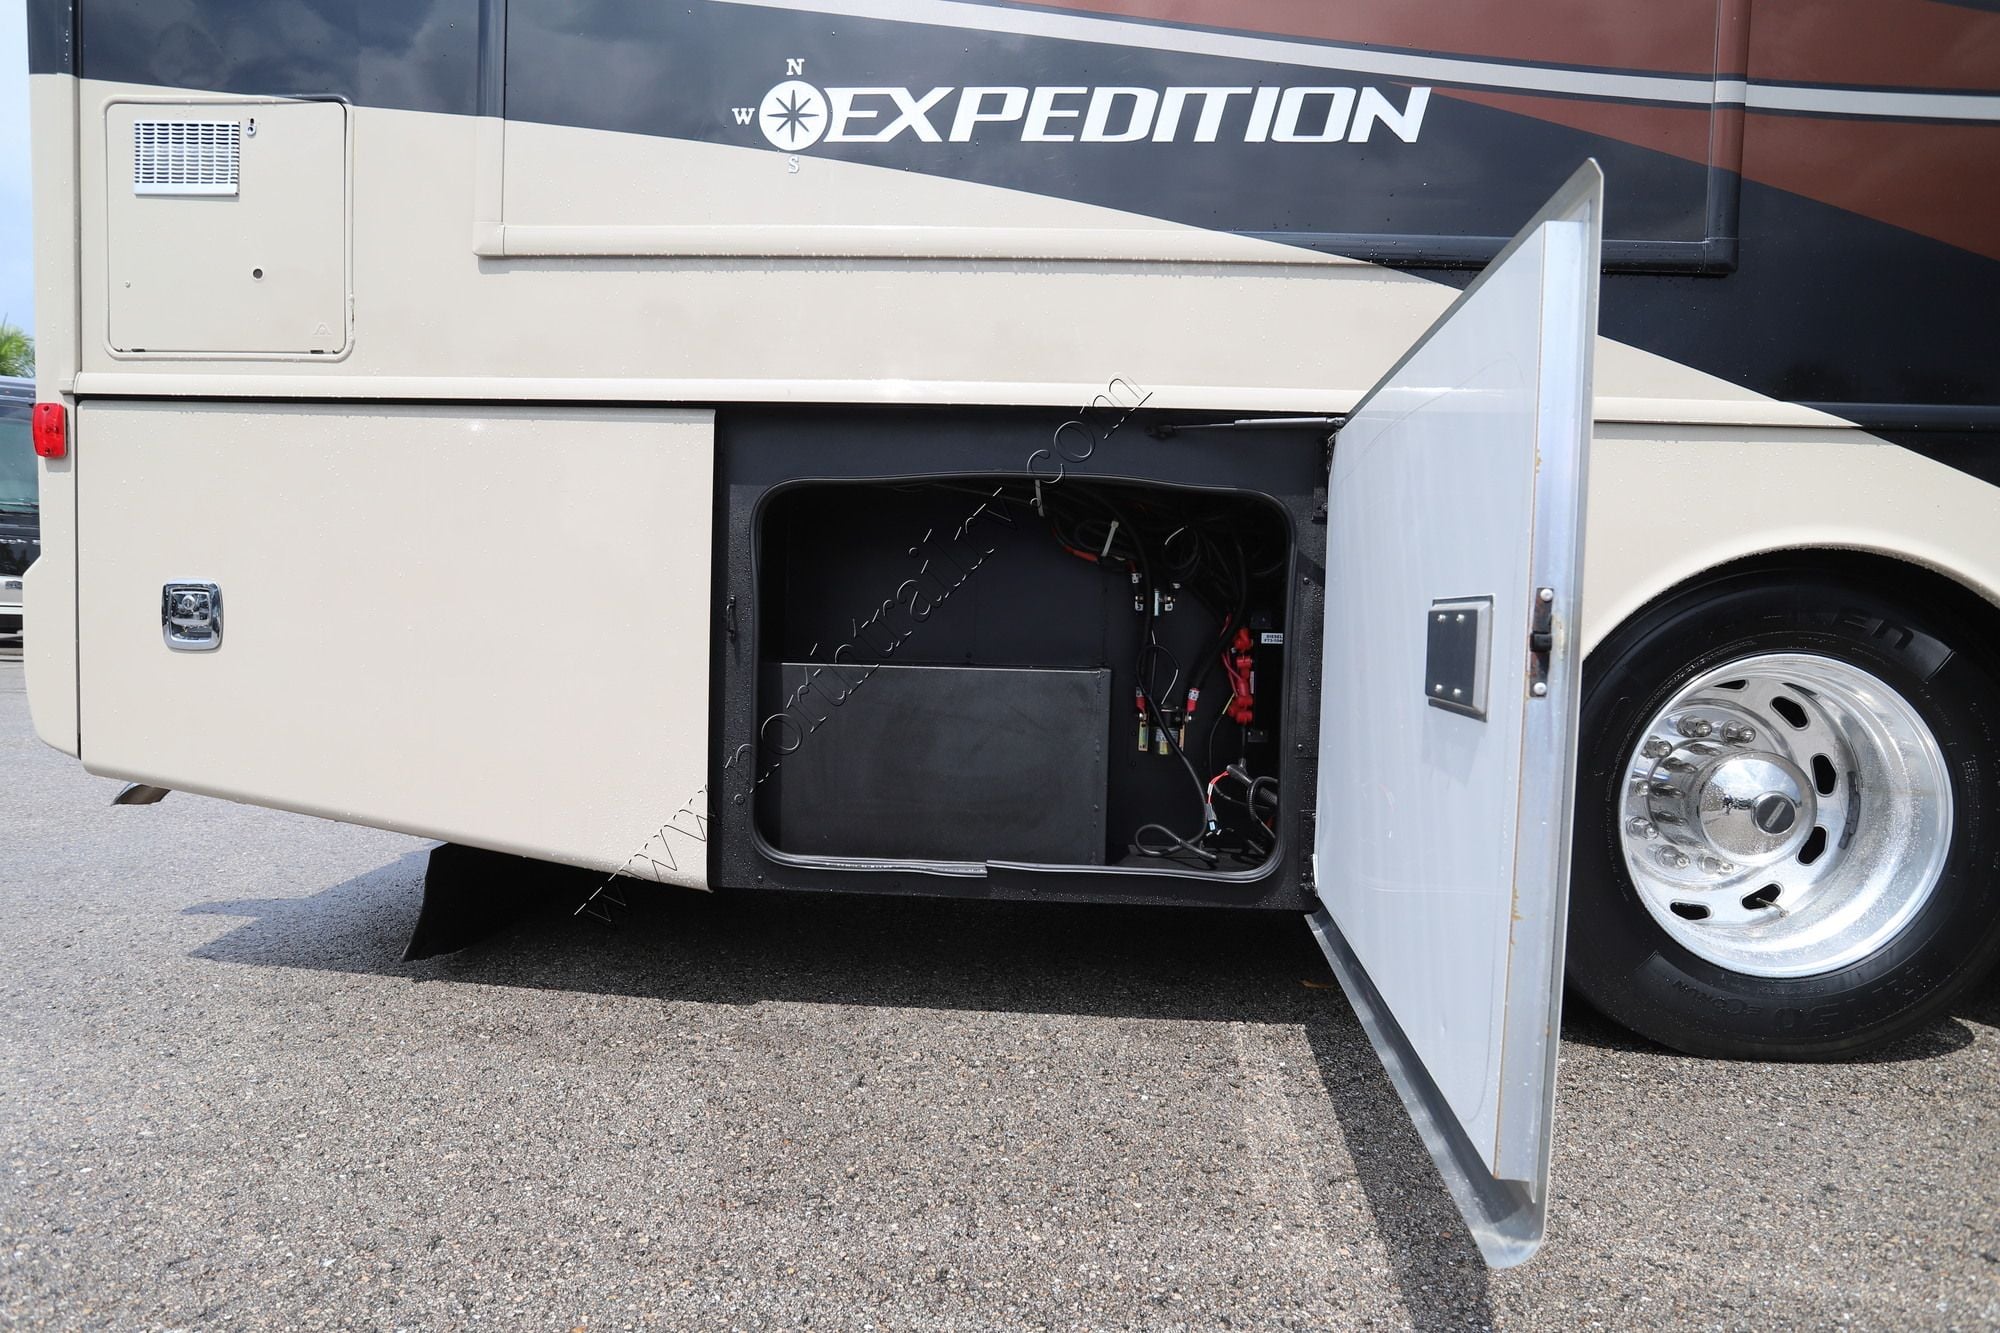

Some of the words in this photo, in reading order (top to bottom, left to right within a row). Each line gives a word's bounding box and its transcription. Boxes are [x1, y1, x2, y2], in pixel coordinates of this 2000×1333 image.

[786, 58, 805, 75] N
[732, 107, 755, 125] W
[823, 86, 1432, 143] EXPEDITION
[788, 155, 800, 174] S
